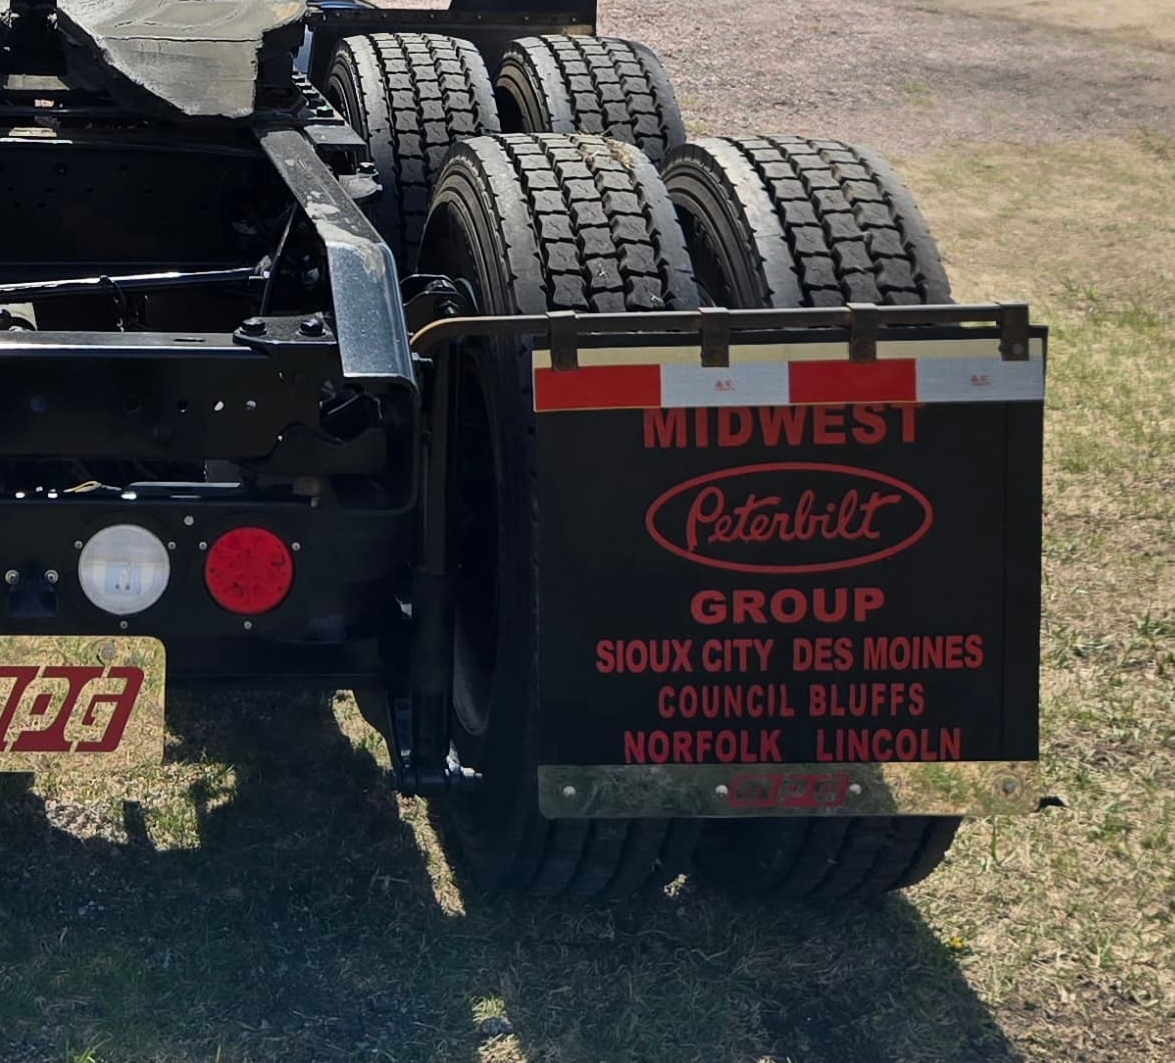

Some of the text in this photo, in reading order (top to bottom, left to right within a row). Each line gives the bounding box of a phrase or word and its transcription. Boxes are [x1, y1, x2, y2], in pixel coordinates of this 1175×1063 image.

[642, 404, 923, 448] MIDWEST
[686, 487, 902, 551] Peterbilt
[691, 587, 885, 625] GROUP
[596, 634, 984, 674] SIOUX CITY DES MOINES
[659, 683, 925, 718] COUNCIL BLUFFS
[624, 728, 961, 764] NORFOLK LINCOLN
